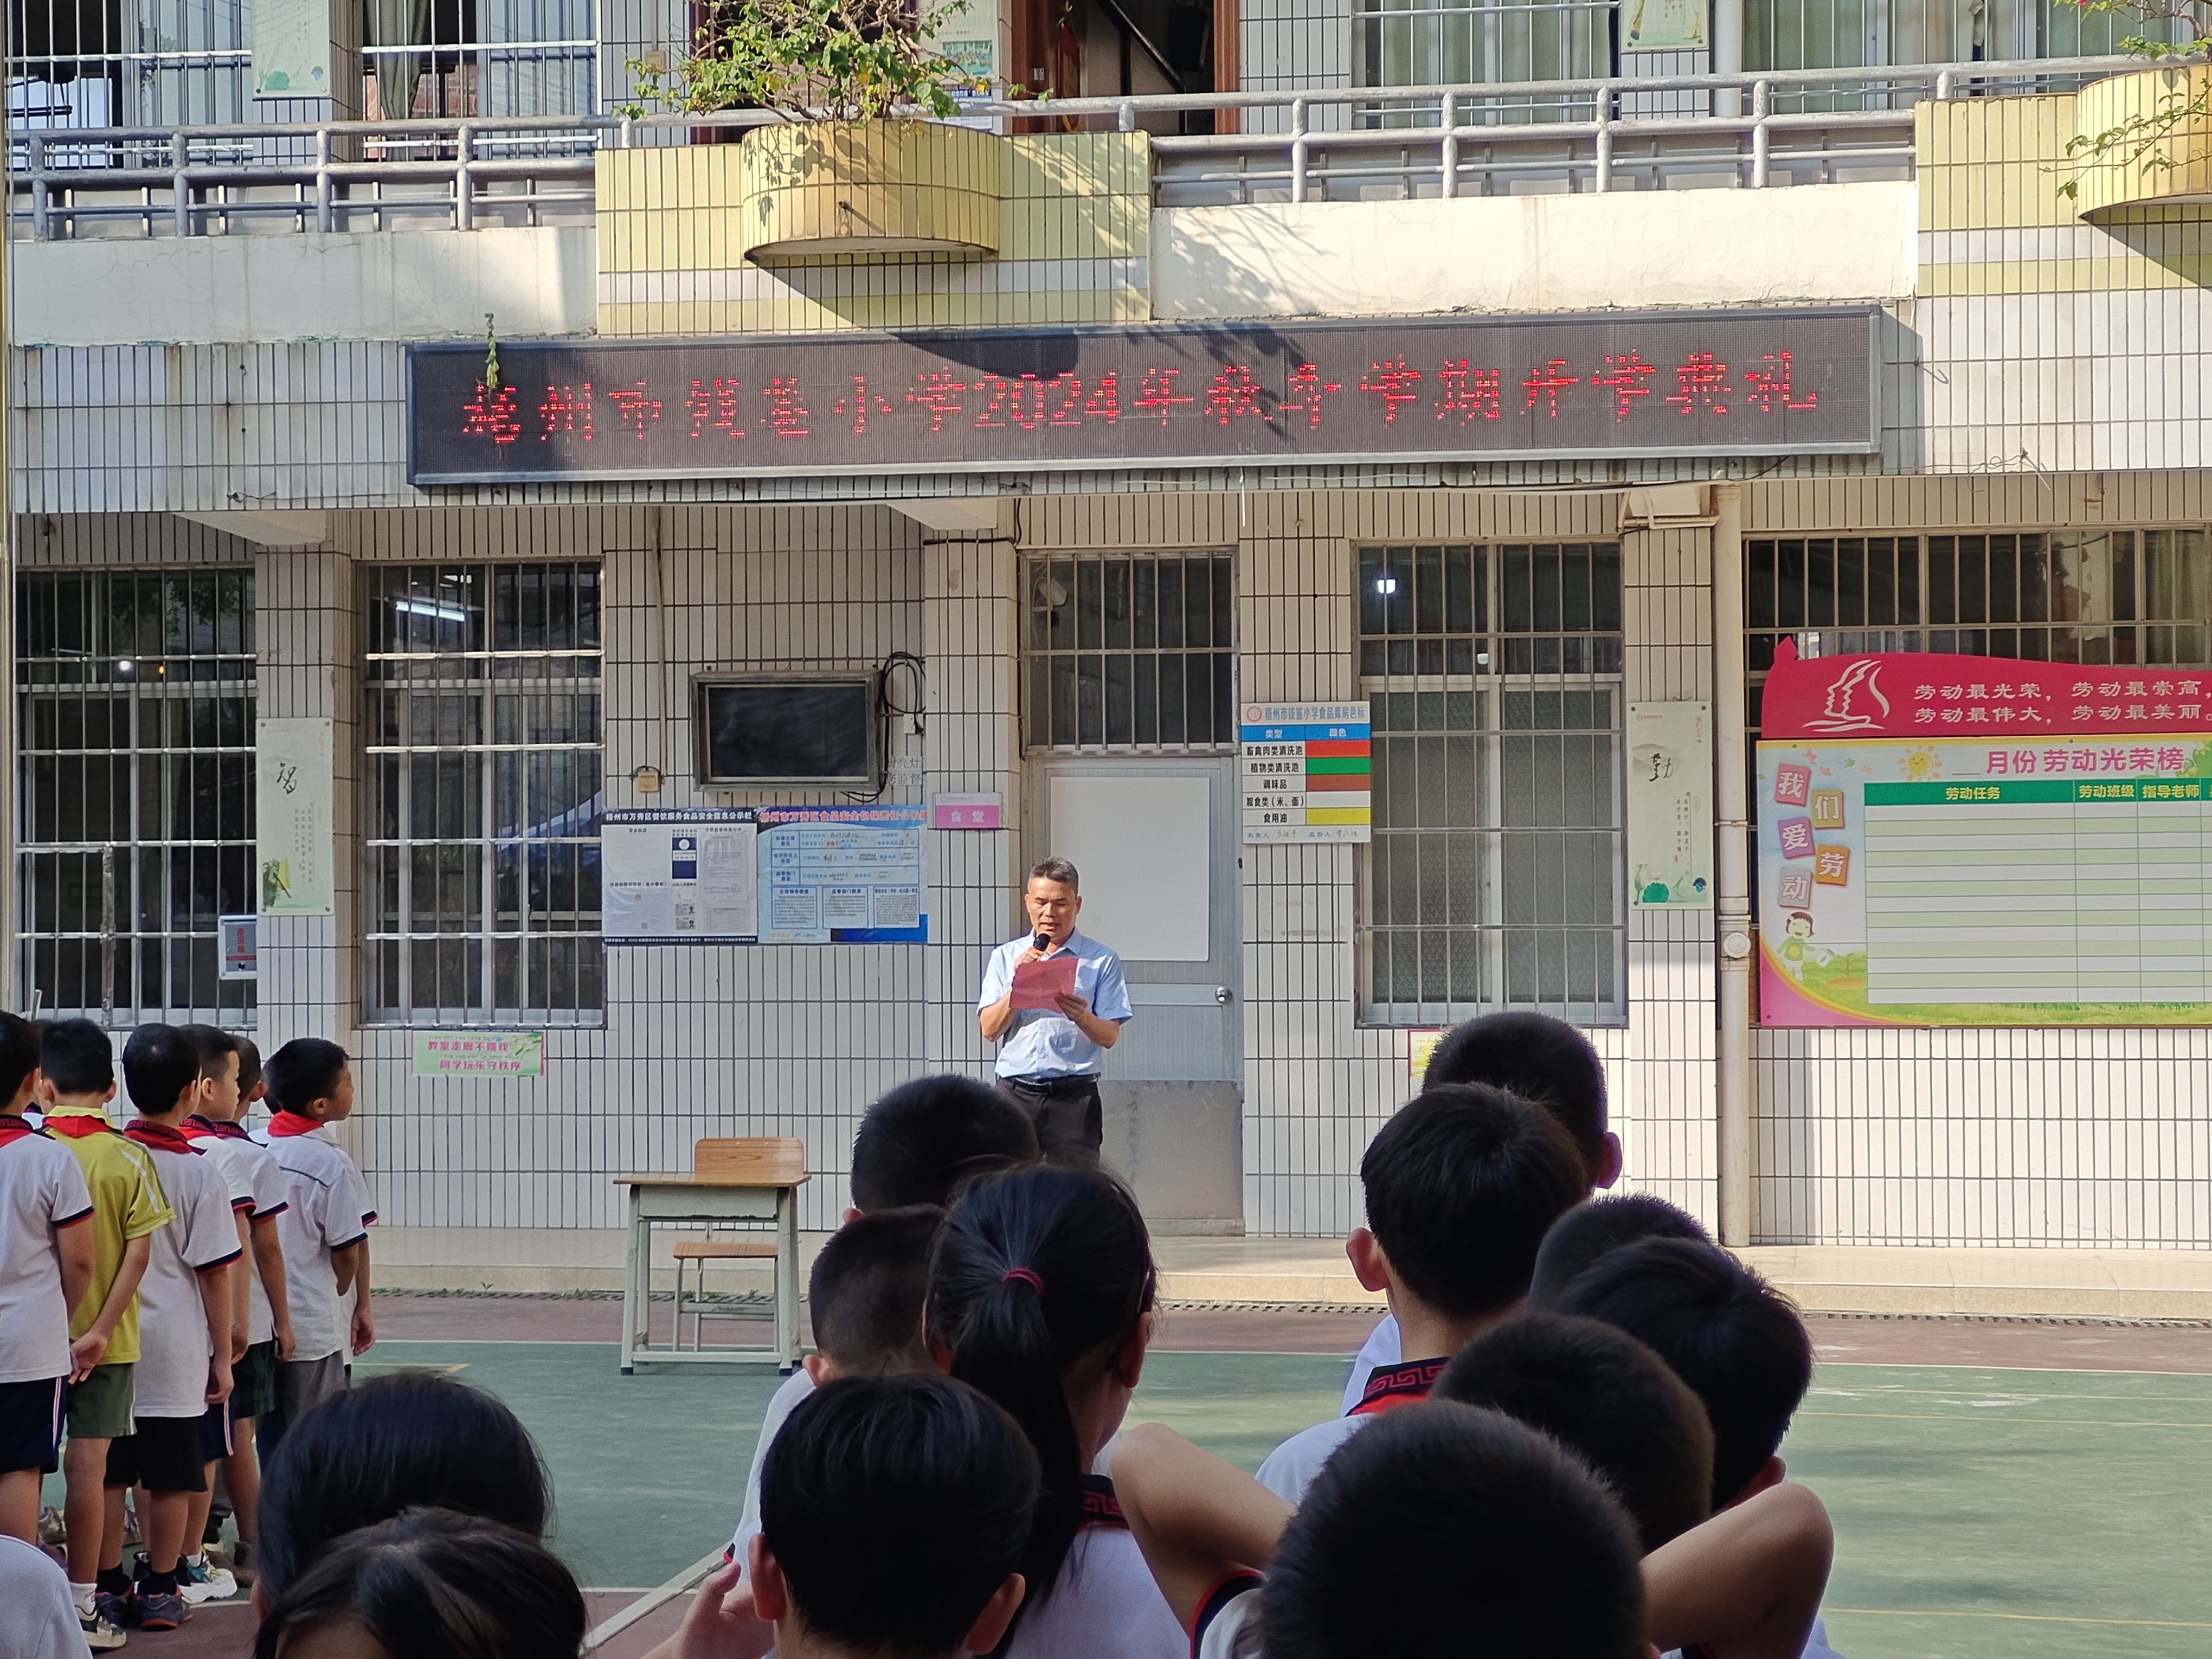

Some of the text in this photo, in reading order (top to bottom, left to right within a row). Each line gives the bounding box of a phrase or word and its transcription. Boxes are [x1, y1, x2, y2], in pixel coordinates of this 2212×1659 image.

[1914, 680, 2211, 702] 劳动最光荣， 劳动最崇高，
[1914, 706, 2052, 725] 劳动最伟大，
[1265, 729, 1283, 738] 类型
[1329, 728, 1347, 737] 颜色
[1246, 746, 1303, 756] 畜禽肉类清洗池
[1985, 747, 2184, 775] 月份 劳动光荣榜
[1251, 763, 1300, 773] 植物类清洗池
[1263, 780, 1287, 790] 调味品
[1945, 787, 2001, 800] 劳动任务
[2079, 785, 2135, 798] 劳动班级
[2142, 785, 2200, 798] 指导老师
[950, 810, 985, 823] 食堂
[1263, 813, 1288, 823] 食用油
[428, 1041, 509, 1052] 教室走廊不嬉戏
[440, 1060, 521, 1071] 同学玩乐守秩序
